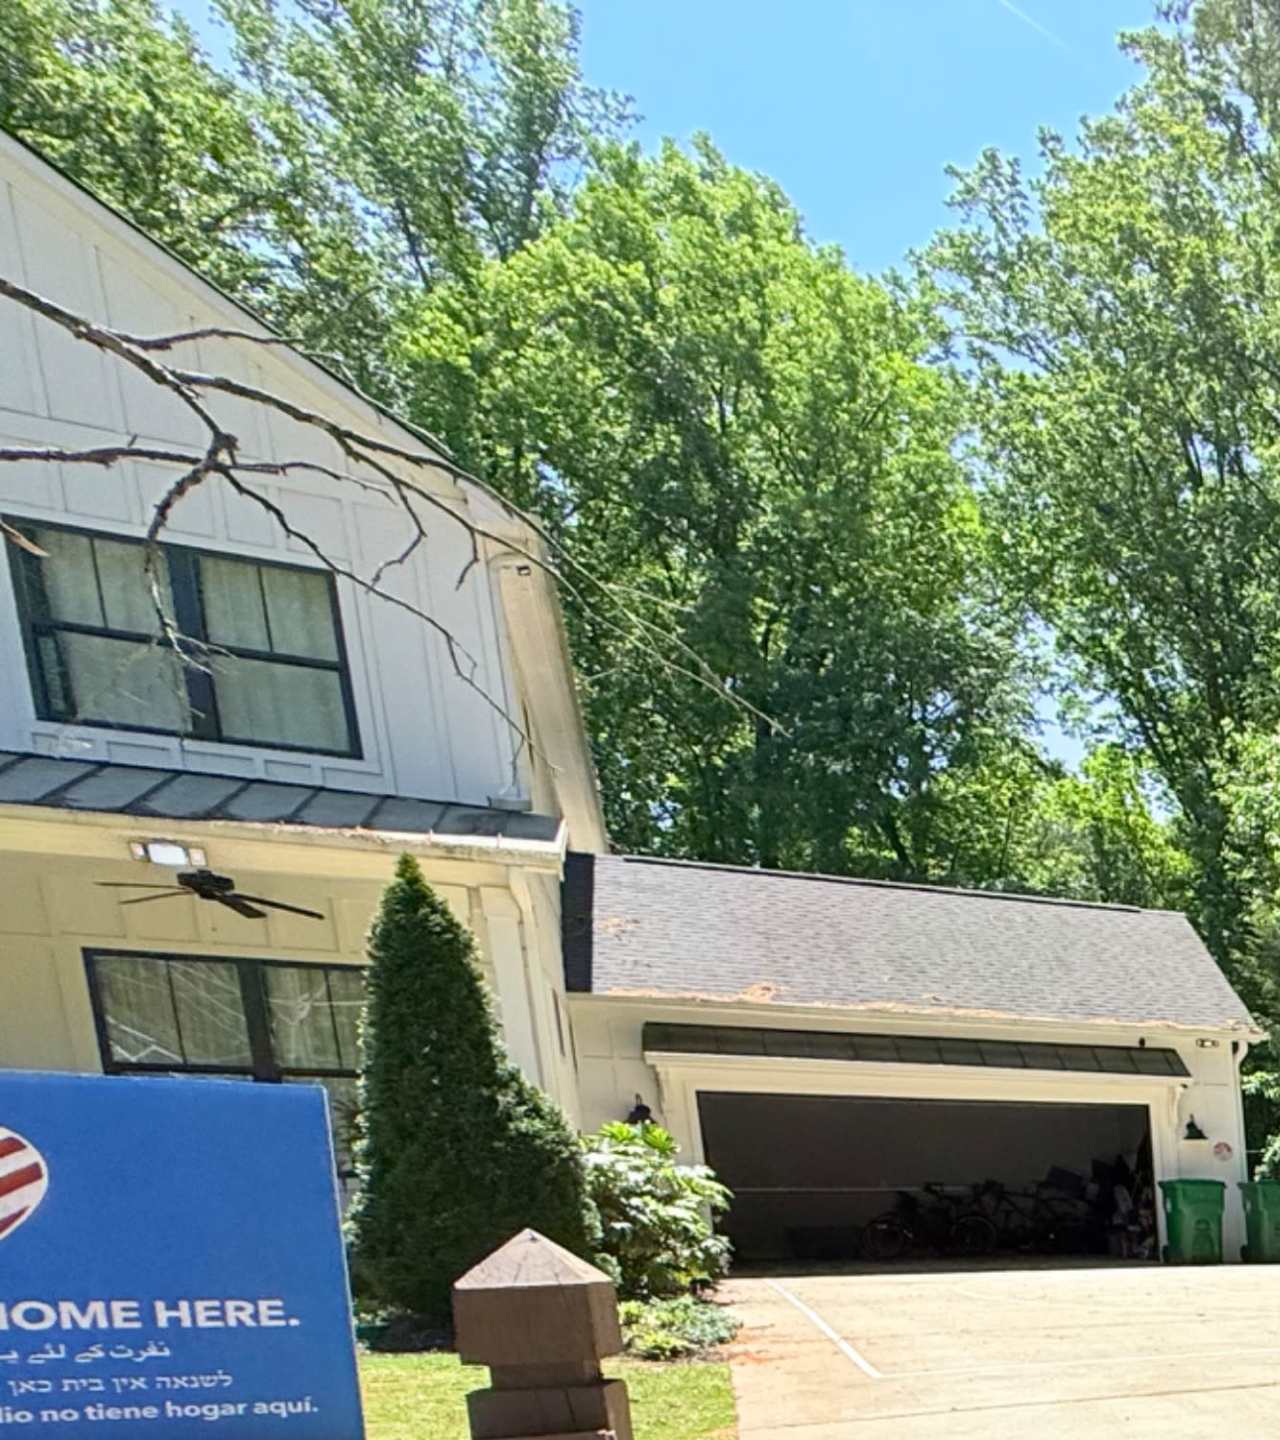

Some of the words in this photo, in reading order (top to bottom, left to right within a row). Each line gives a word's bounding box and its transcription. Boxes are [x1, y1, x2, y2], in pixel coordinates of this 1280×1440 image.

[0, 1300, 143, 1331] OME
[154, 1299, 300, 1328] HERE.
[7, 1379, 51, 1397] כאן
[62, 1378, 105, 1392] בית
[112, 1376, 148, 1394] אין
[155, 1369, 233, 1390] לשנאה
[0, 1405, 34, 1425] io
[40, 1408, 79, 1423] no
[84, 1402, 158, 1421] tiene
[165, 1400, 247, 1421] hogar
[253, 1396, 319, 1418] aquí.
